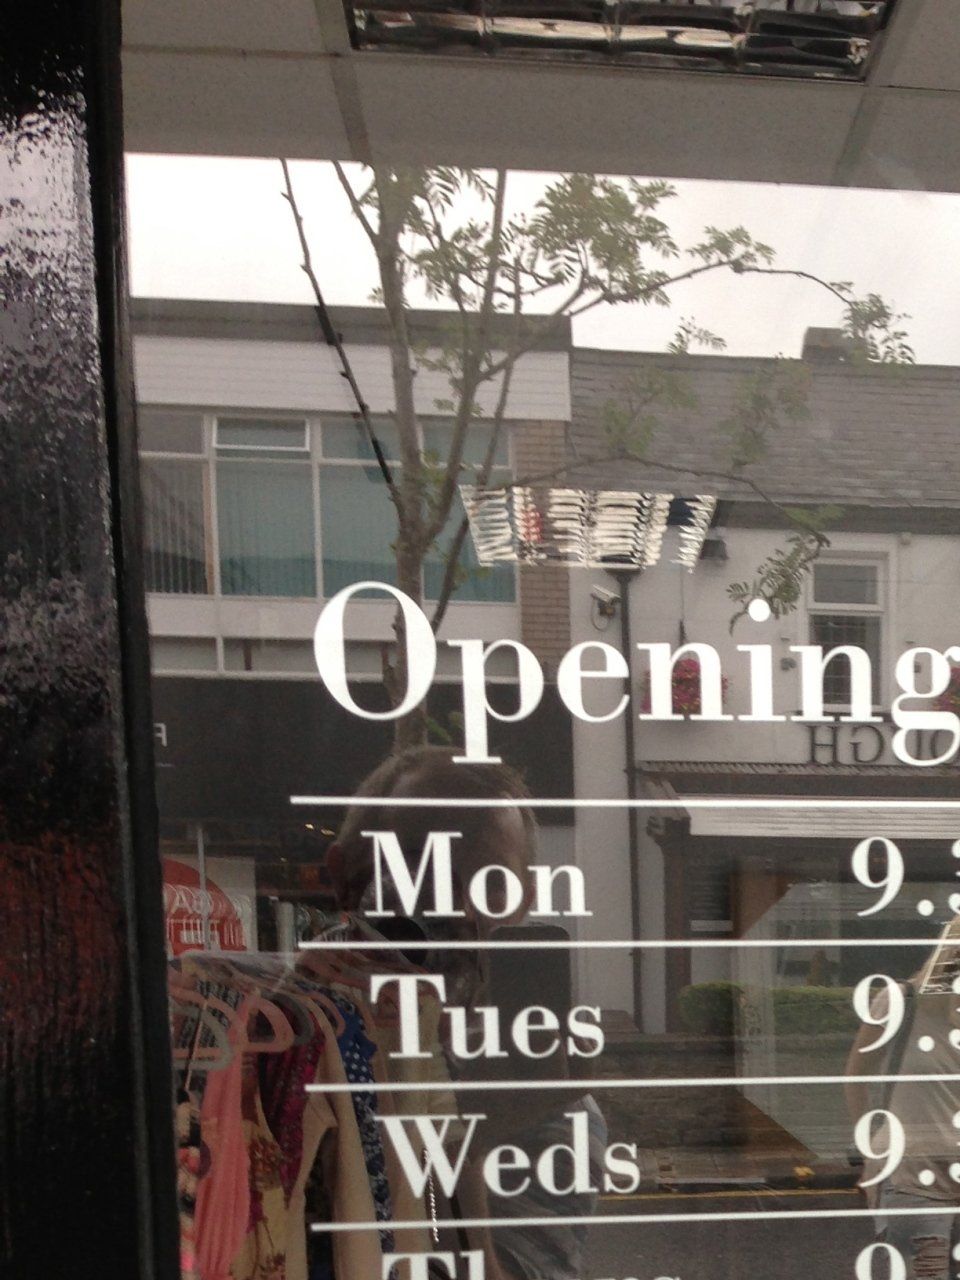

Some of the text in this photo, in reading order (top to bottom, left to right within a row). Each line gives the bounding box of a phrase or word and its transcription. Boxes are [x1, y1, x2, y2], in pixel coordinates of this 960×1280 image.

[361, 832, 593, 917] Mon
[371, 974, 606, 1058] Tues
[376, 1112, 642, 1198] Weds
